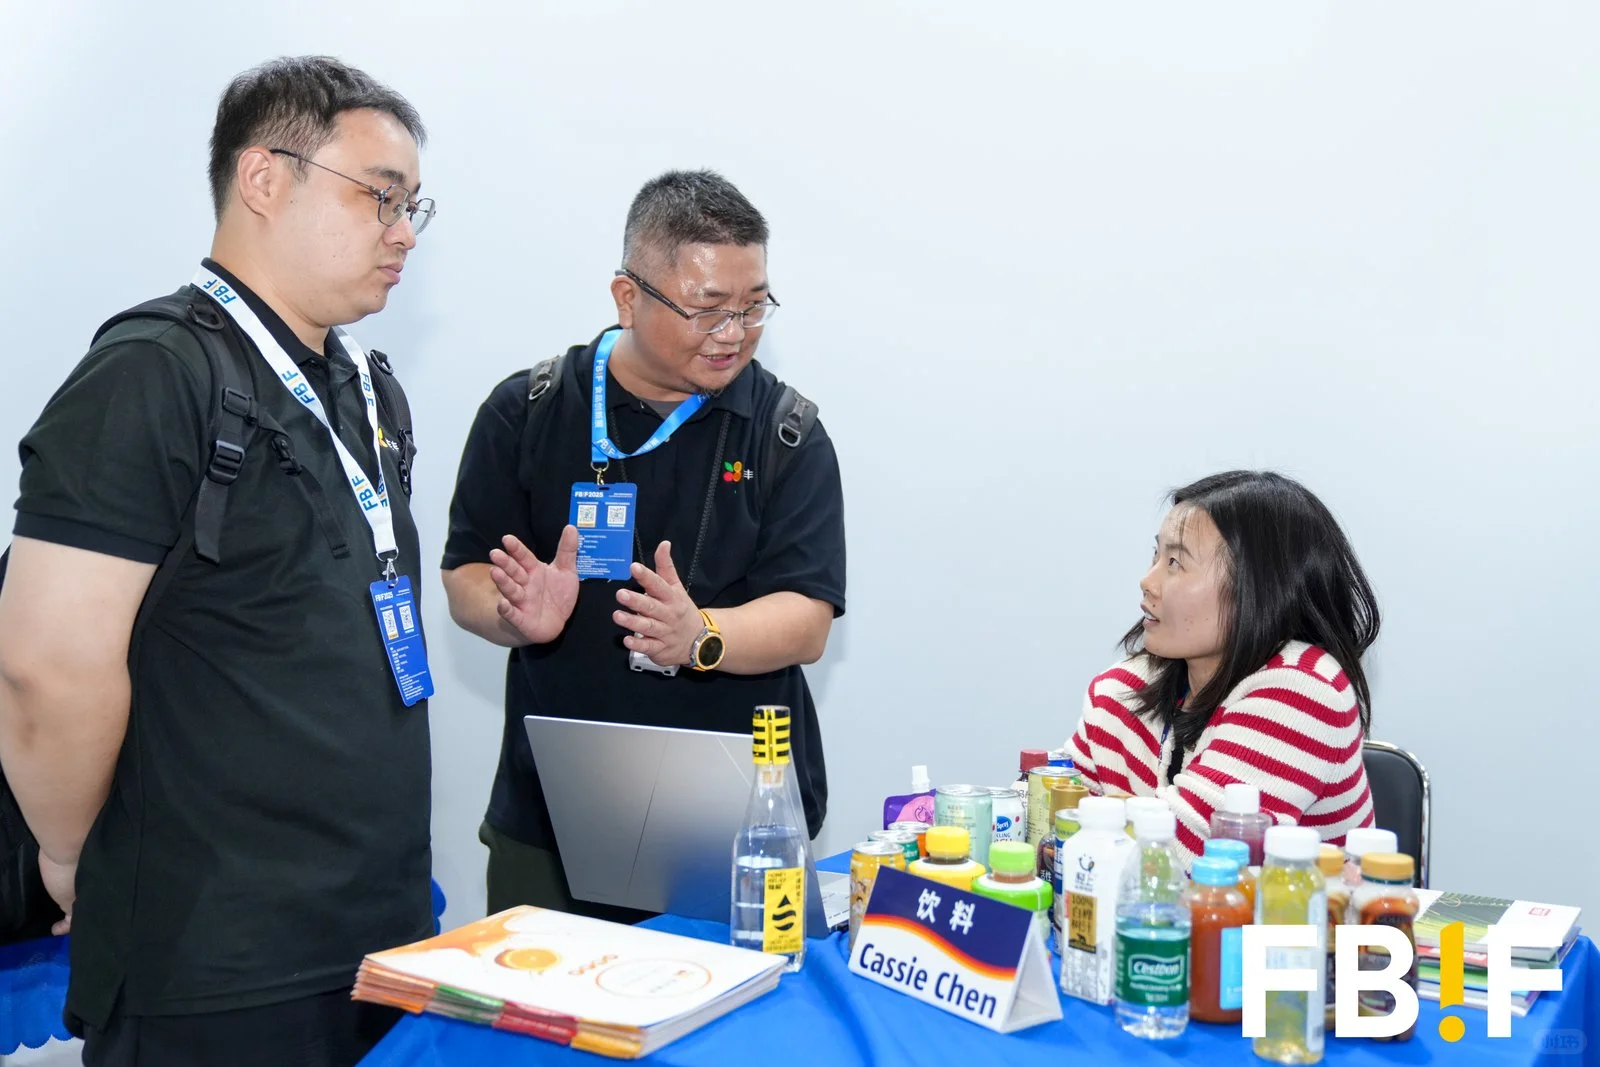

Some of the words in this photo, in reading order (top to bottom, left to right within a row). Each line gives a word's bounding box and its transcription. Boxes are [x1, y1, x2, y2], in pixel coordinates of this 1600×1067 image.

[916, 888, 976, 935] 饮料
[859, 943, 928, 991] Cassie
[934, 971, 997, 1019] Chen
